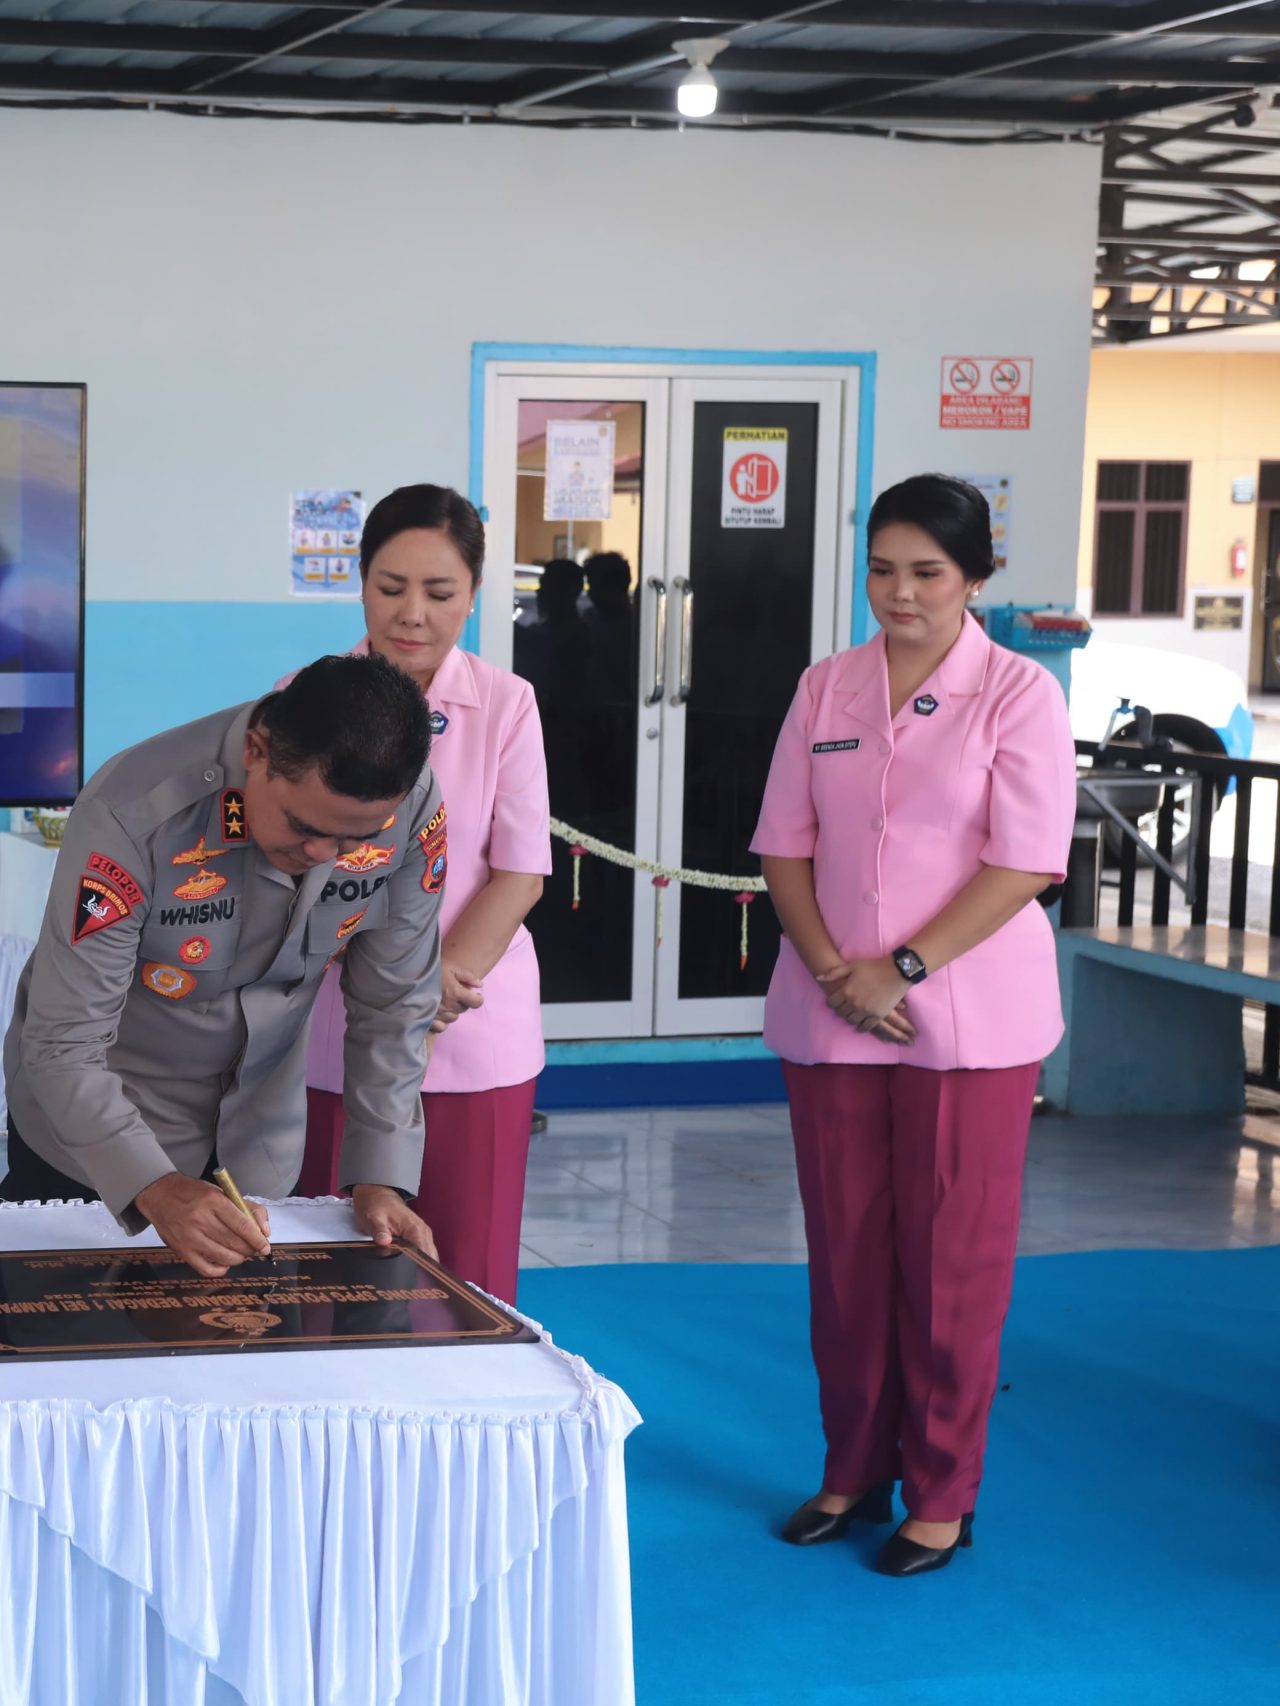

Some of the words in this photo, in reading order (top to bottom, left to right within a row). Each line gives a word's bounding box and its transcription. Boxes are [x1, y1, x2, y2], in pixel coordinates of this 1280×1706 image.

[726, 431, 785, 440] PERHATIAN
[91, 856, 141, 906] PELOPOR
[83, 879, 106, 894] KORPS
[105, 890, 128, 915] BRIMOB
[160, 897, 235, 926] WHISNU
[263, 1292, 331, 1304] POLRES
[330, 1290, 378, 1301] SPPG
[376, 1288, 449, 1300] GEDUNG
[58, 1300, 90, 1311] SEI
[105, 1297, 181, 1309] BEDAGAI
[181, 1295, 263, 1307] SERDANG
